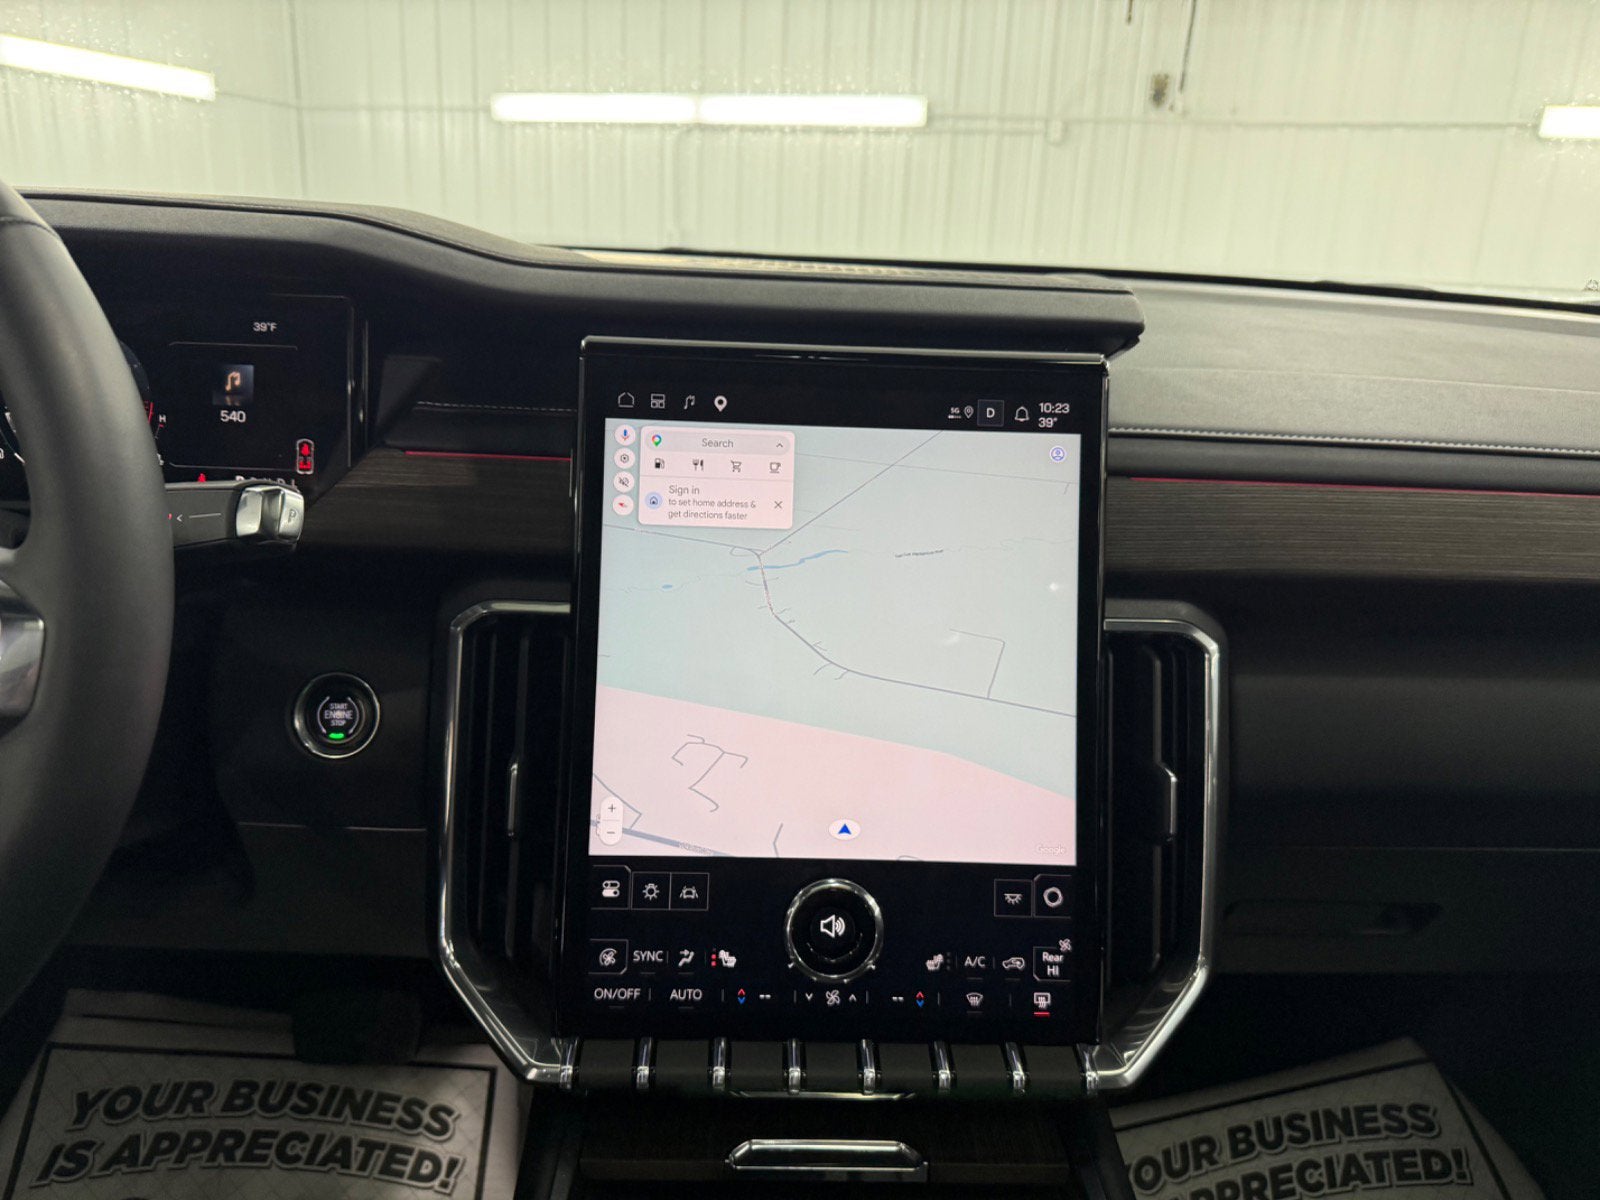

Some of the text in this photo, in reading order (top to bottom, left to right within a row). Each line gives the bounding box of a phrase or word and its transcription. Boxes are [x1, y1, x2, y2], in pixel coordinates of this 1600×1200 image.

[985, 407, 996, 419] D
[1038, 402, 1070, 414] 10:23
[159, 414, 167, 423] H
[220, 410, 247, 423] 540
[1038, 416, 1058, 428] 39°
[701, 437, 734, 448] Search
[668, 484, 700, 496] Sign in
[693, 499, 715, 507] home
[716, 499, 749, 508] address
[668, 509, 748, 520] get directions faster
[329, 702, 349, 710] START
[324, 710, 352, 719] ENGINE
[633, 950, 664, 963] SYNC
[964, 956, 986, 968] A/C
[1042, 952, 1064, 963] Rear
[594, 987, 641, 1000] ON/OFF
[669, 988, 703, 1000] AUTO
[72, 1080, 458, 1140] YOUR BUSINESS
[1128, 1104, 1438, 1194] OUR BUSINESS
[34, 1130, 465, 1193] IS APPRECIATED!
[1170, 1148, 1473, 1200] PRECIATED!
